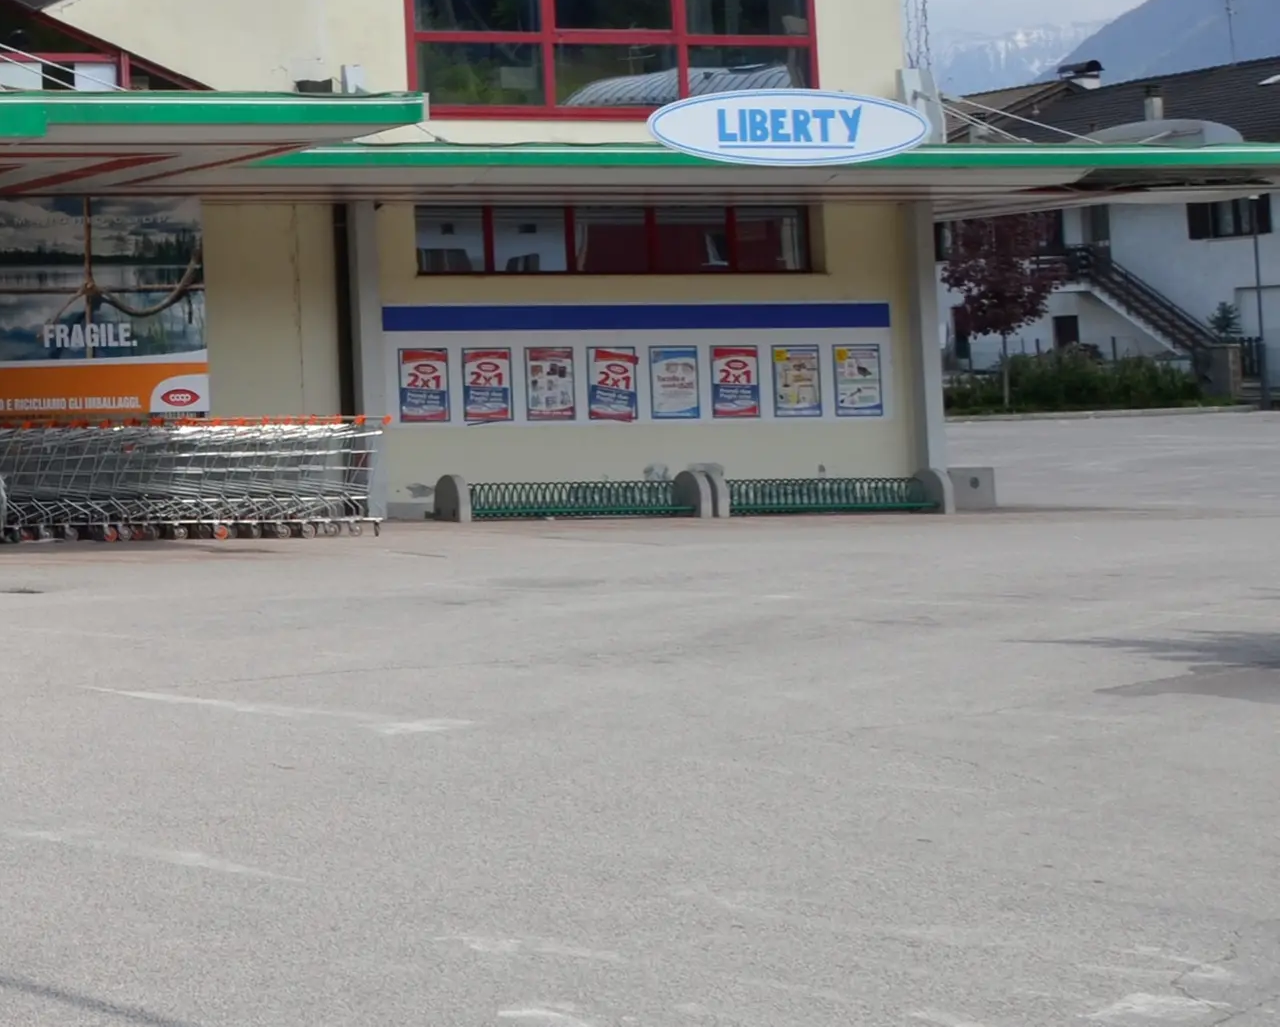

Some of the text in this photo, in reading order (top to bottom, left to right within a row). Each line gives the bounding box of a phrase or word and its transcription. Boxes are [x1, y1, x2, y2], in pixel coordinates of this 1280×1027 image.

[717, 104, 862, 143] LIBERTY
[43, 323, 138, 348] FRAGILE.
[407, 373, 441, 389] 2x1
[469, 371, 503, 386] 2x1
[597, 371, 631, 390] 2x1
[719, 369, 752, 384] 2x1
[6, 398, 13, 411] E
[14, 397, 67, 411] RICICLIAMO
[68, 397, 83, 410] GLI
[169, 394, 192, 404] coop
